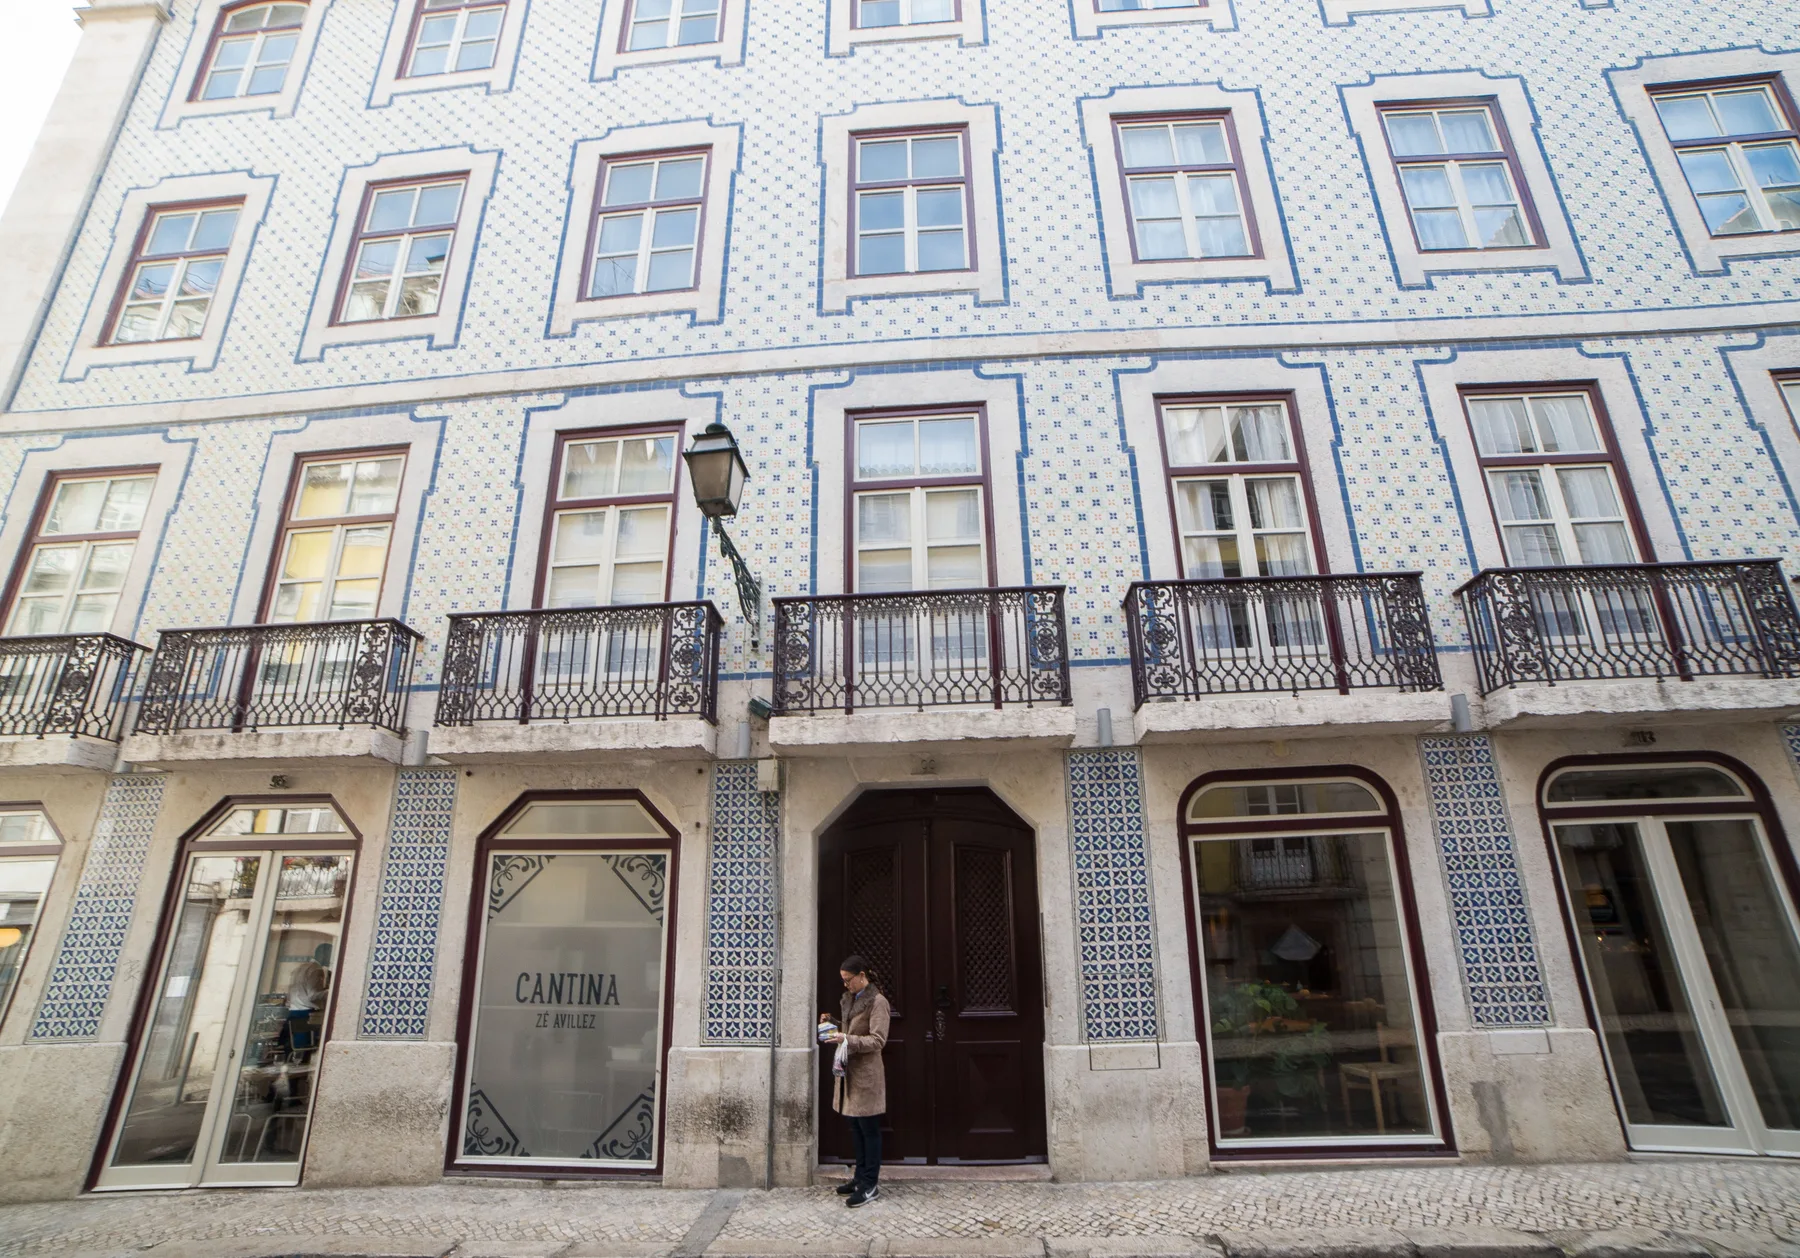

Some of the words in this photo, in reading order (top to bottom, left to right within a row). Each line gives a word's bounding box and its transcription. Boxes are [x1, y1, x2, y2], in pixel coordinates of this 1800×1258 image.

[515, 972, 620, 1005] CANTINA
[535, 1011, 549, 1028] ZÉ
[553, 1013, 596, 1029] AVILLEZ
